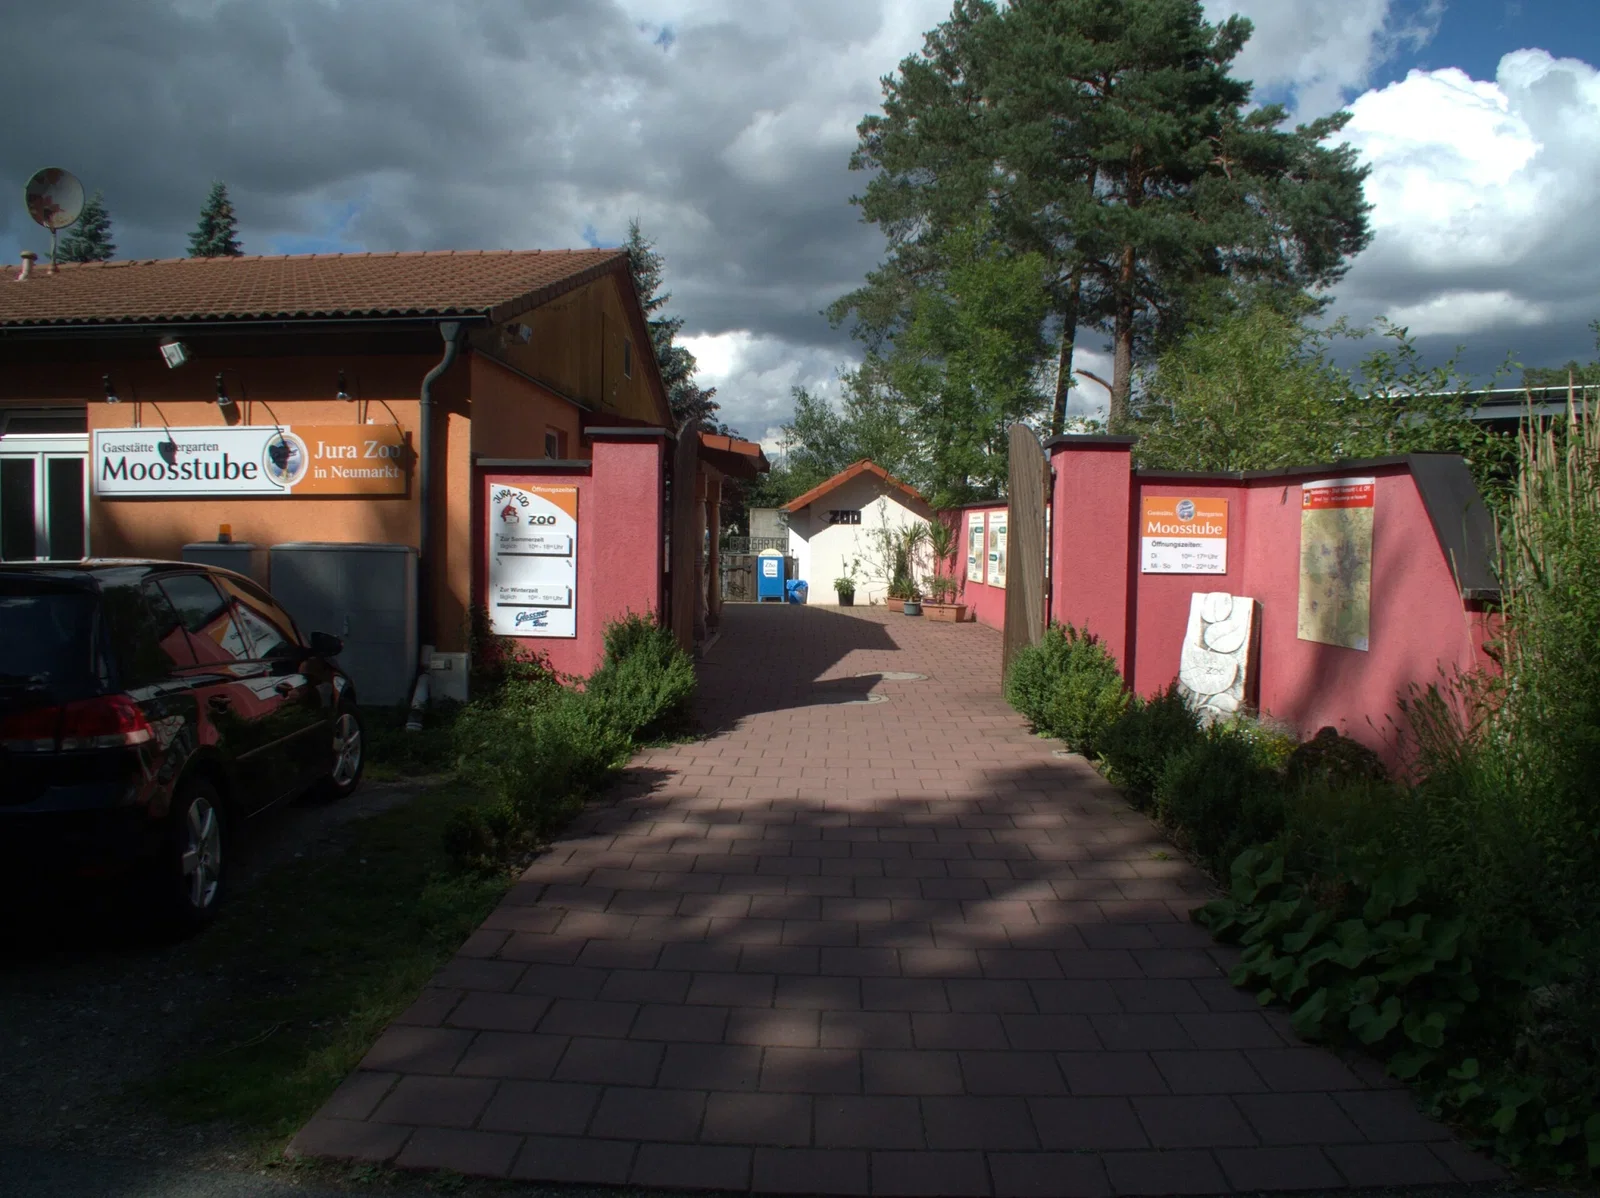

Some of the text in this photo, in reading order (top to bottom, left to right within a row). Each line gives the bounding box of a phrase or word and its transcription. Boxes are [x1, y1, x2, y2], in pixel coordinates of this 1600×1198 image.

[102, 442, 154, 454] Gaststätte
[314, 440, 401, 460] Jura Zoo
[102, 453, 258, 481] Moosstube
[314, 465, 400, 479] in Neumarkt
[528, 515, 556, 525] ZOO
[829, 510, 862, 525] ZOO
[1147, 521, 1223, 535] Moosstube
